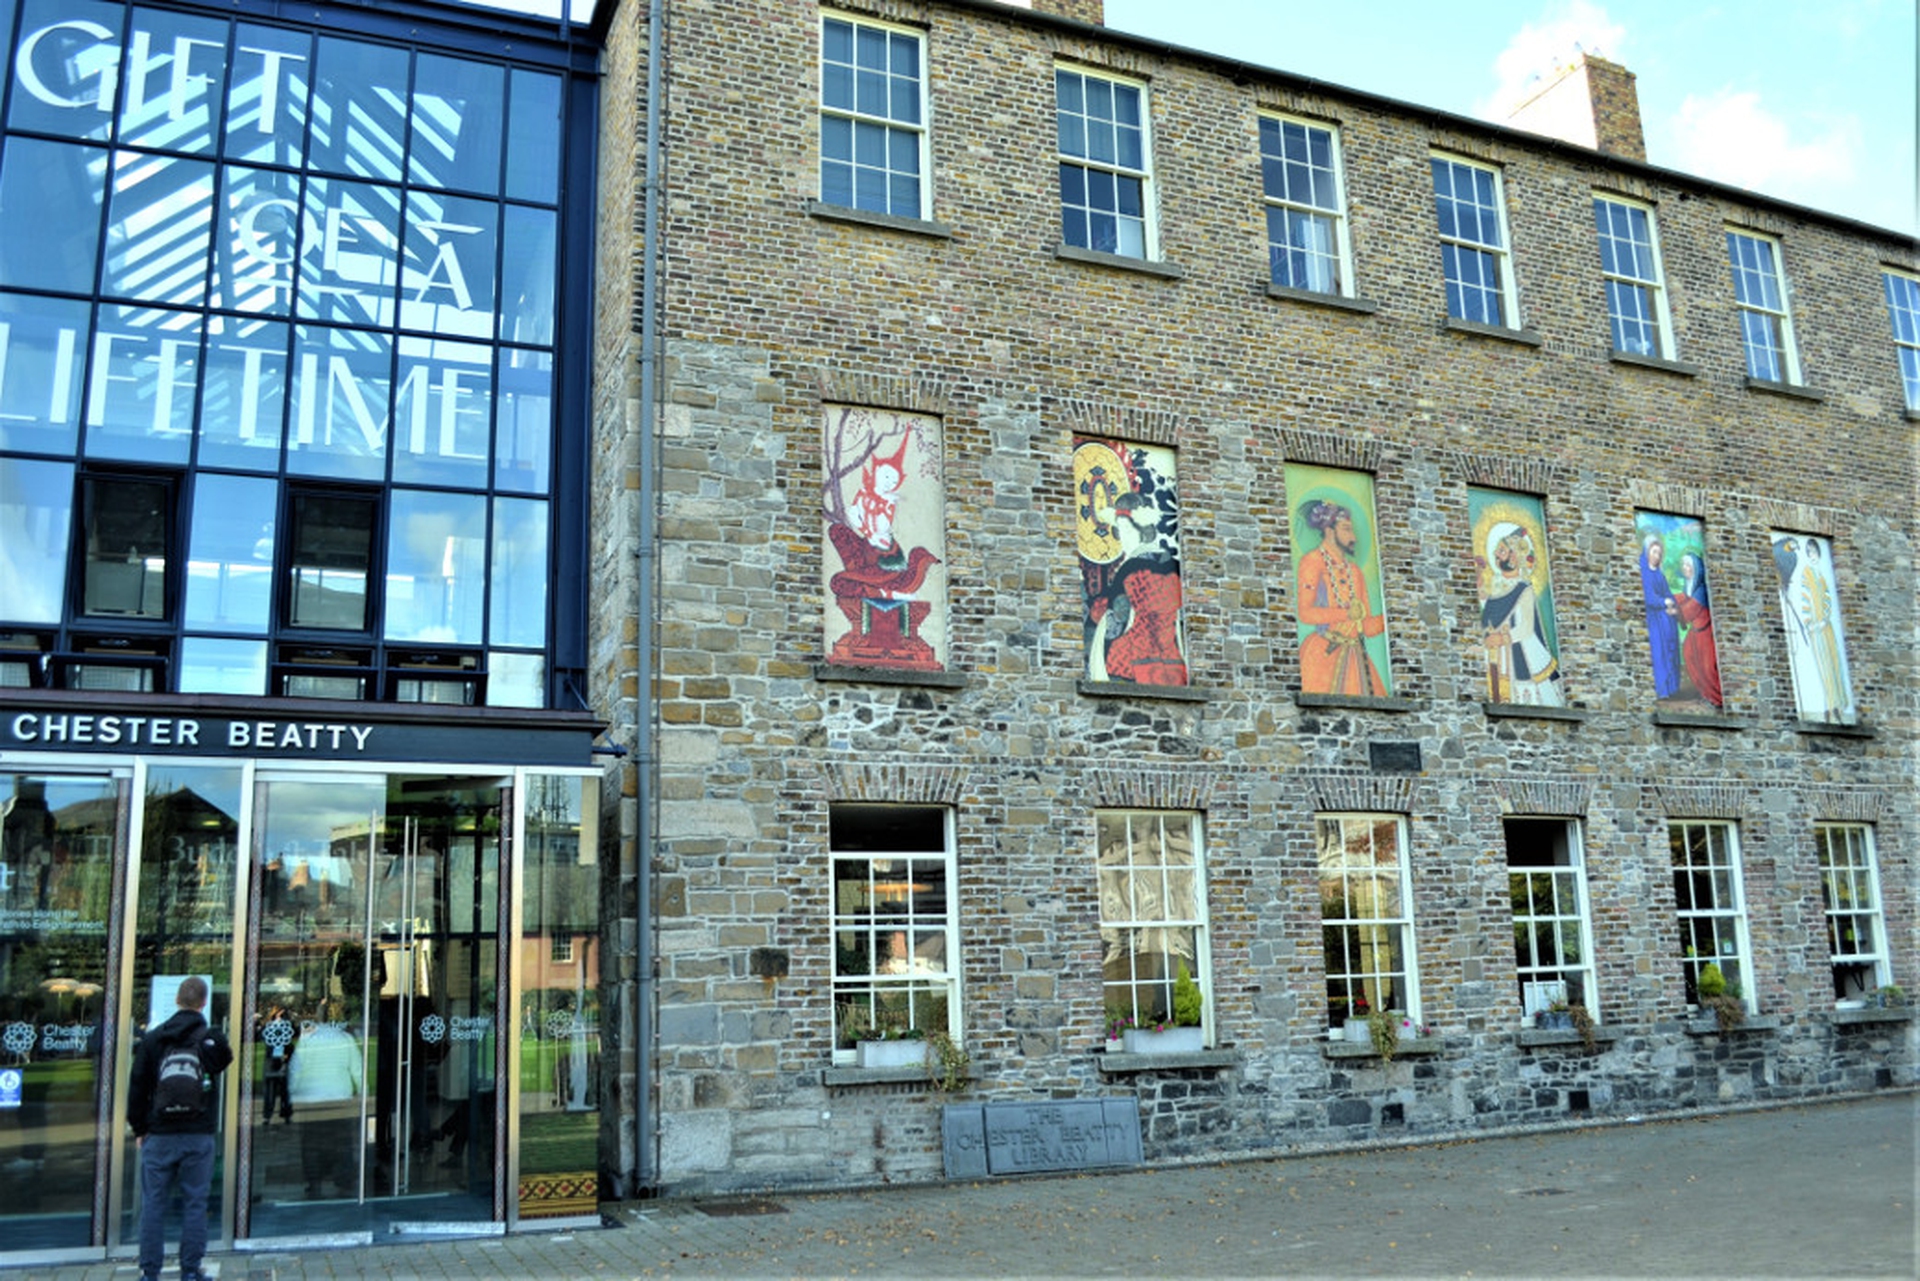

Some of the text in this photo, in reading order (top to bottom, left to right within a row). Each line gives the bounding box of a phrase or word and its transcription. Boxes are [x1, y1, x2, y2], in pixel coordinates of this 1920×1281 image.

[15, 20, 306, 134] GIFT
[238, 199, 474, 311] OF A
[0, 322, 490, 460] LIFETIME
[12, 713, 373, 750] CHESTER BEATTY
[43, 1022, 96, 1036] Chester
[43, 1037, 88, 1053] Beatty
[1025, 1108, 1064, 1125] THE
[956, 1122, 1130, 1151] CHESTER BEATTY
[1011, 1144, 1089, 1166] LIBRARY
